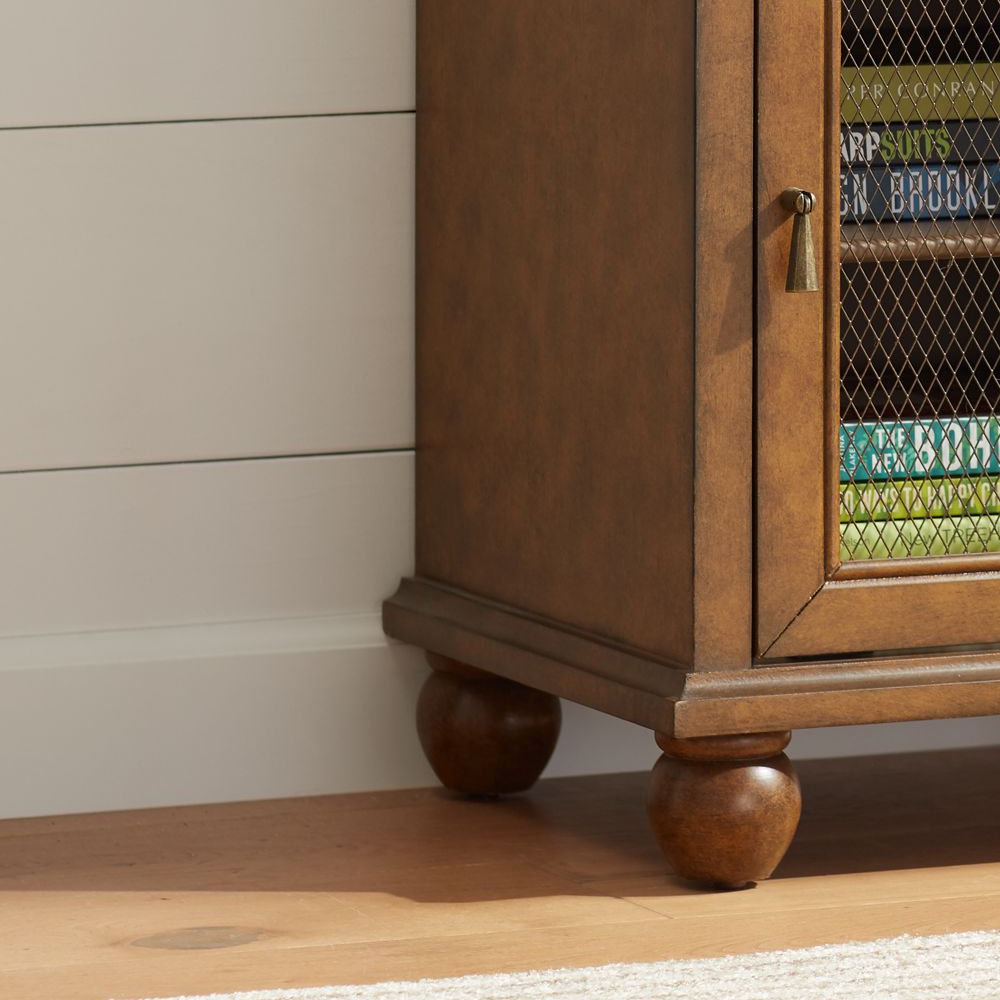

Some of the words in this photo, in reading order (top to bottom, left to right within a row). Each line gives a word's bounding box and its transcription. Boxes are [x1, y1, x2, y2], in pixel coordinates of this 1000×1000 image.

[898, 80, 995, 99] CONRAN
[875, 428, 905, 449] THE
[871, 452, 907, 474] NEW
[859, 487, 899, 514] WAYS
[903, 486, 922, 511] TO
[927, 484, 976, 510] HAPPY
